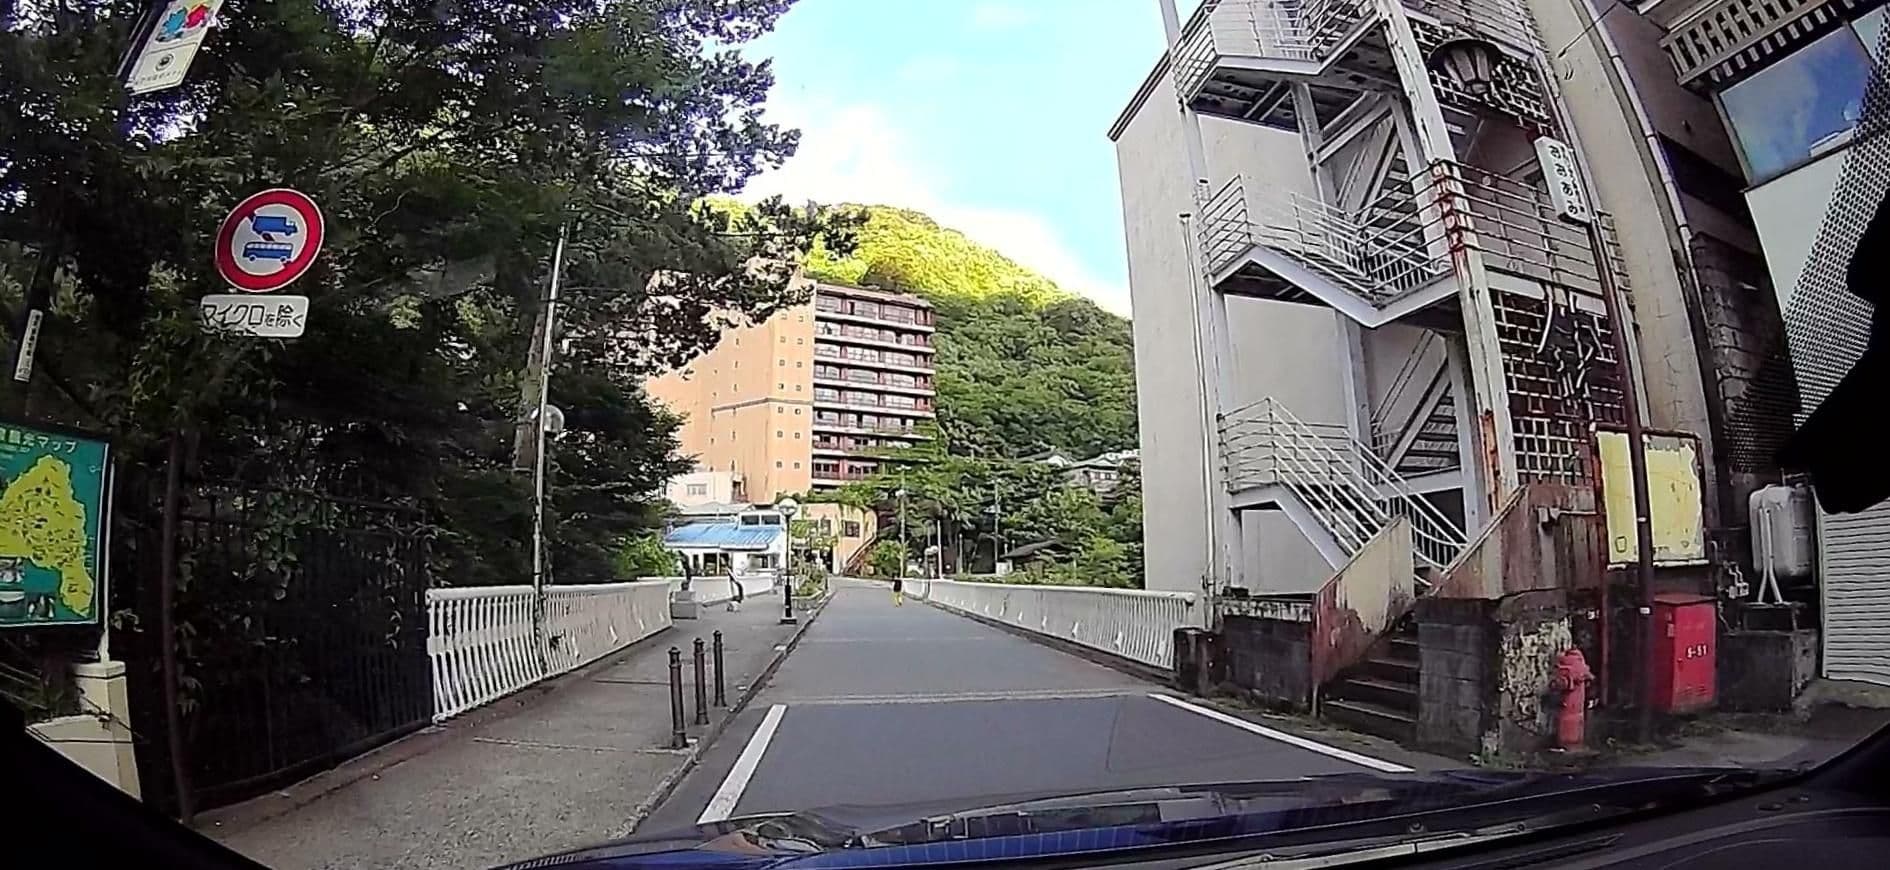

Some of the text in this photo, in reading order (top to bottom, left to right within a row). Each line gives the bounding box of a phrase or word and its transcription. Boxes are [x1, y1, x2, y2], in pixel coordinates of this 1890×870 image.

[203, 304, 304, 327] マイクロを除く
